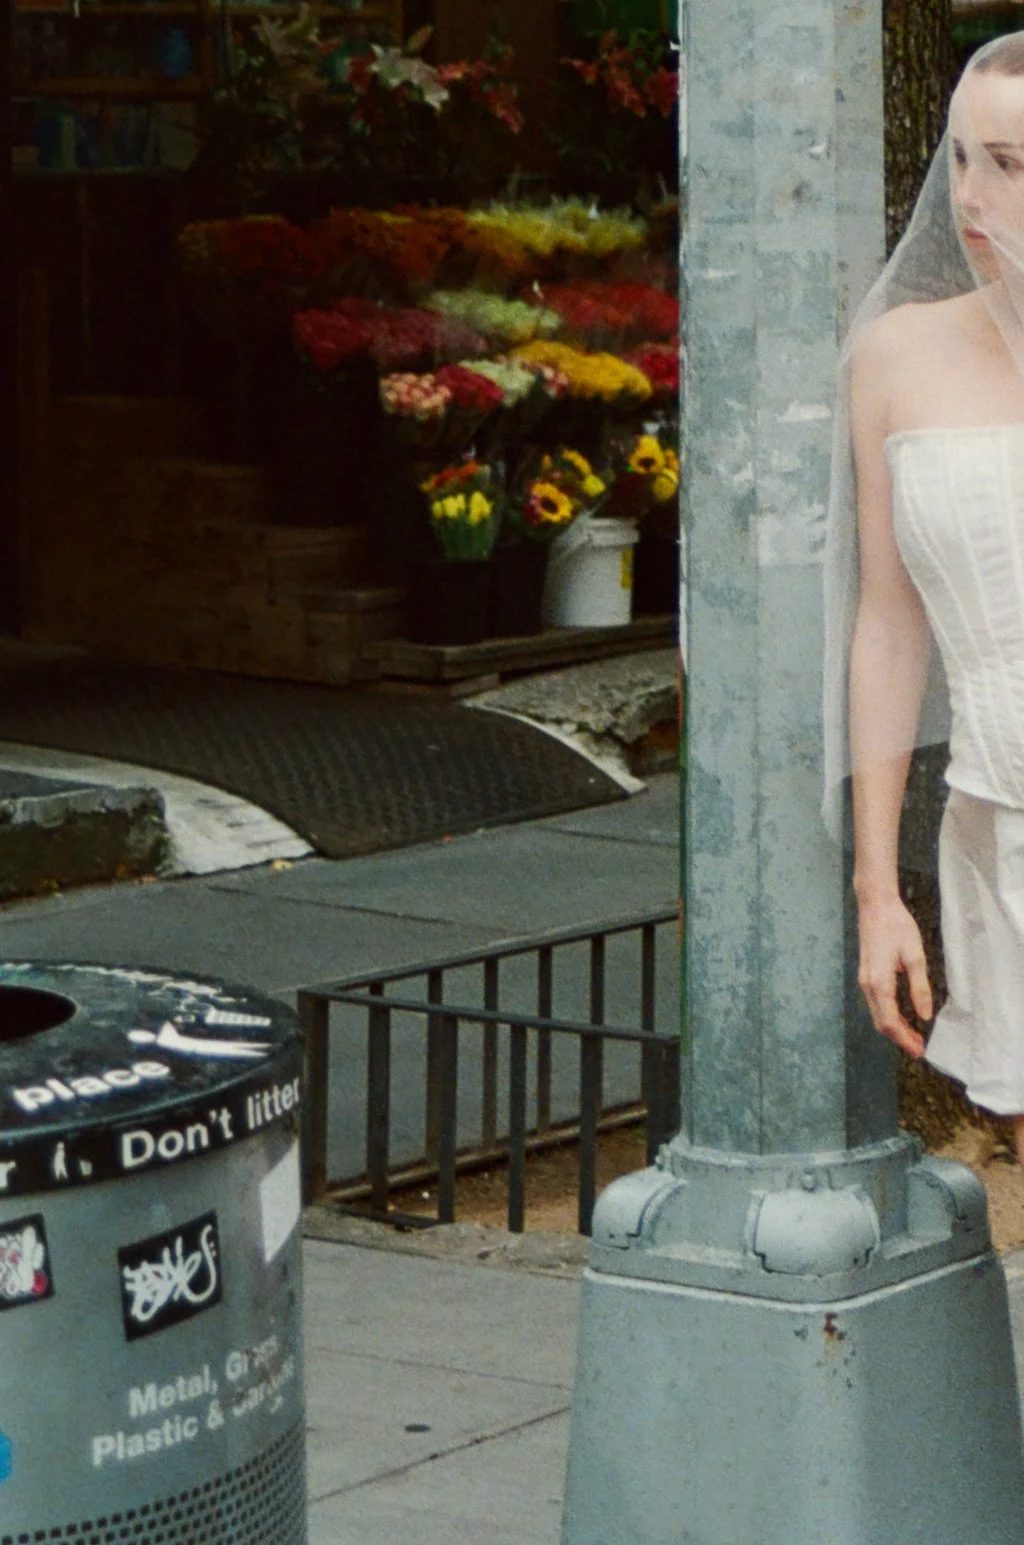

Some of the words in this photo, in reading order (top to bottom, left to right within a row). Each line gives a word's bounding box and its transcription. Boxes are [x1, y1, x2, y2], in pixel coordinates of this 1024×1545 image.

[13, 1061, 170, 1112] place
[122, 1107, 234, 1169] Don't
[247, 1077, 300, 1129] litter
[129, 1364, 218, 1418] Metal,
[92, 1414, 199, 1467] Plastic
[207, 1398, 225, 1431] &
